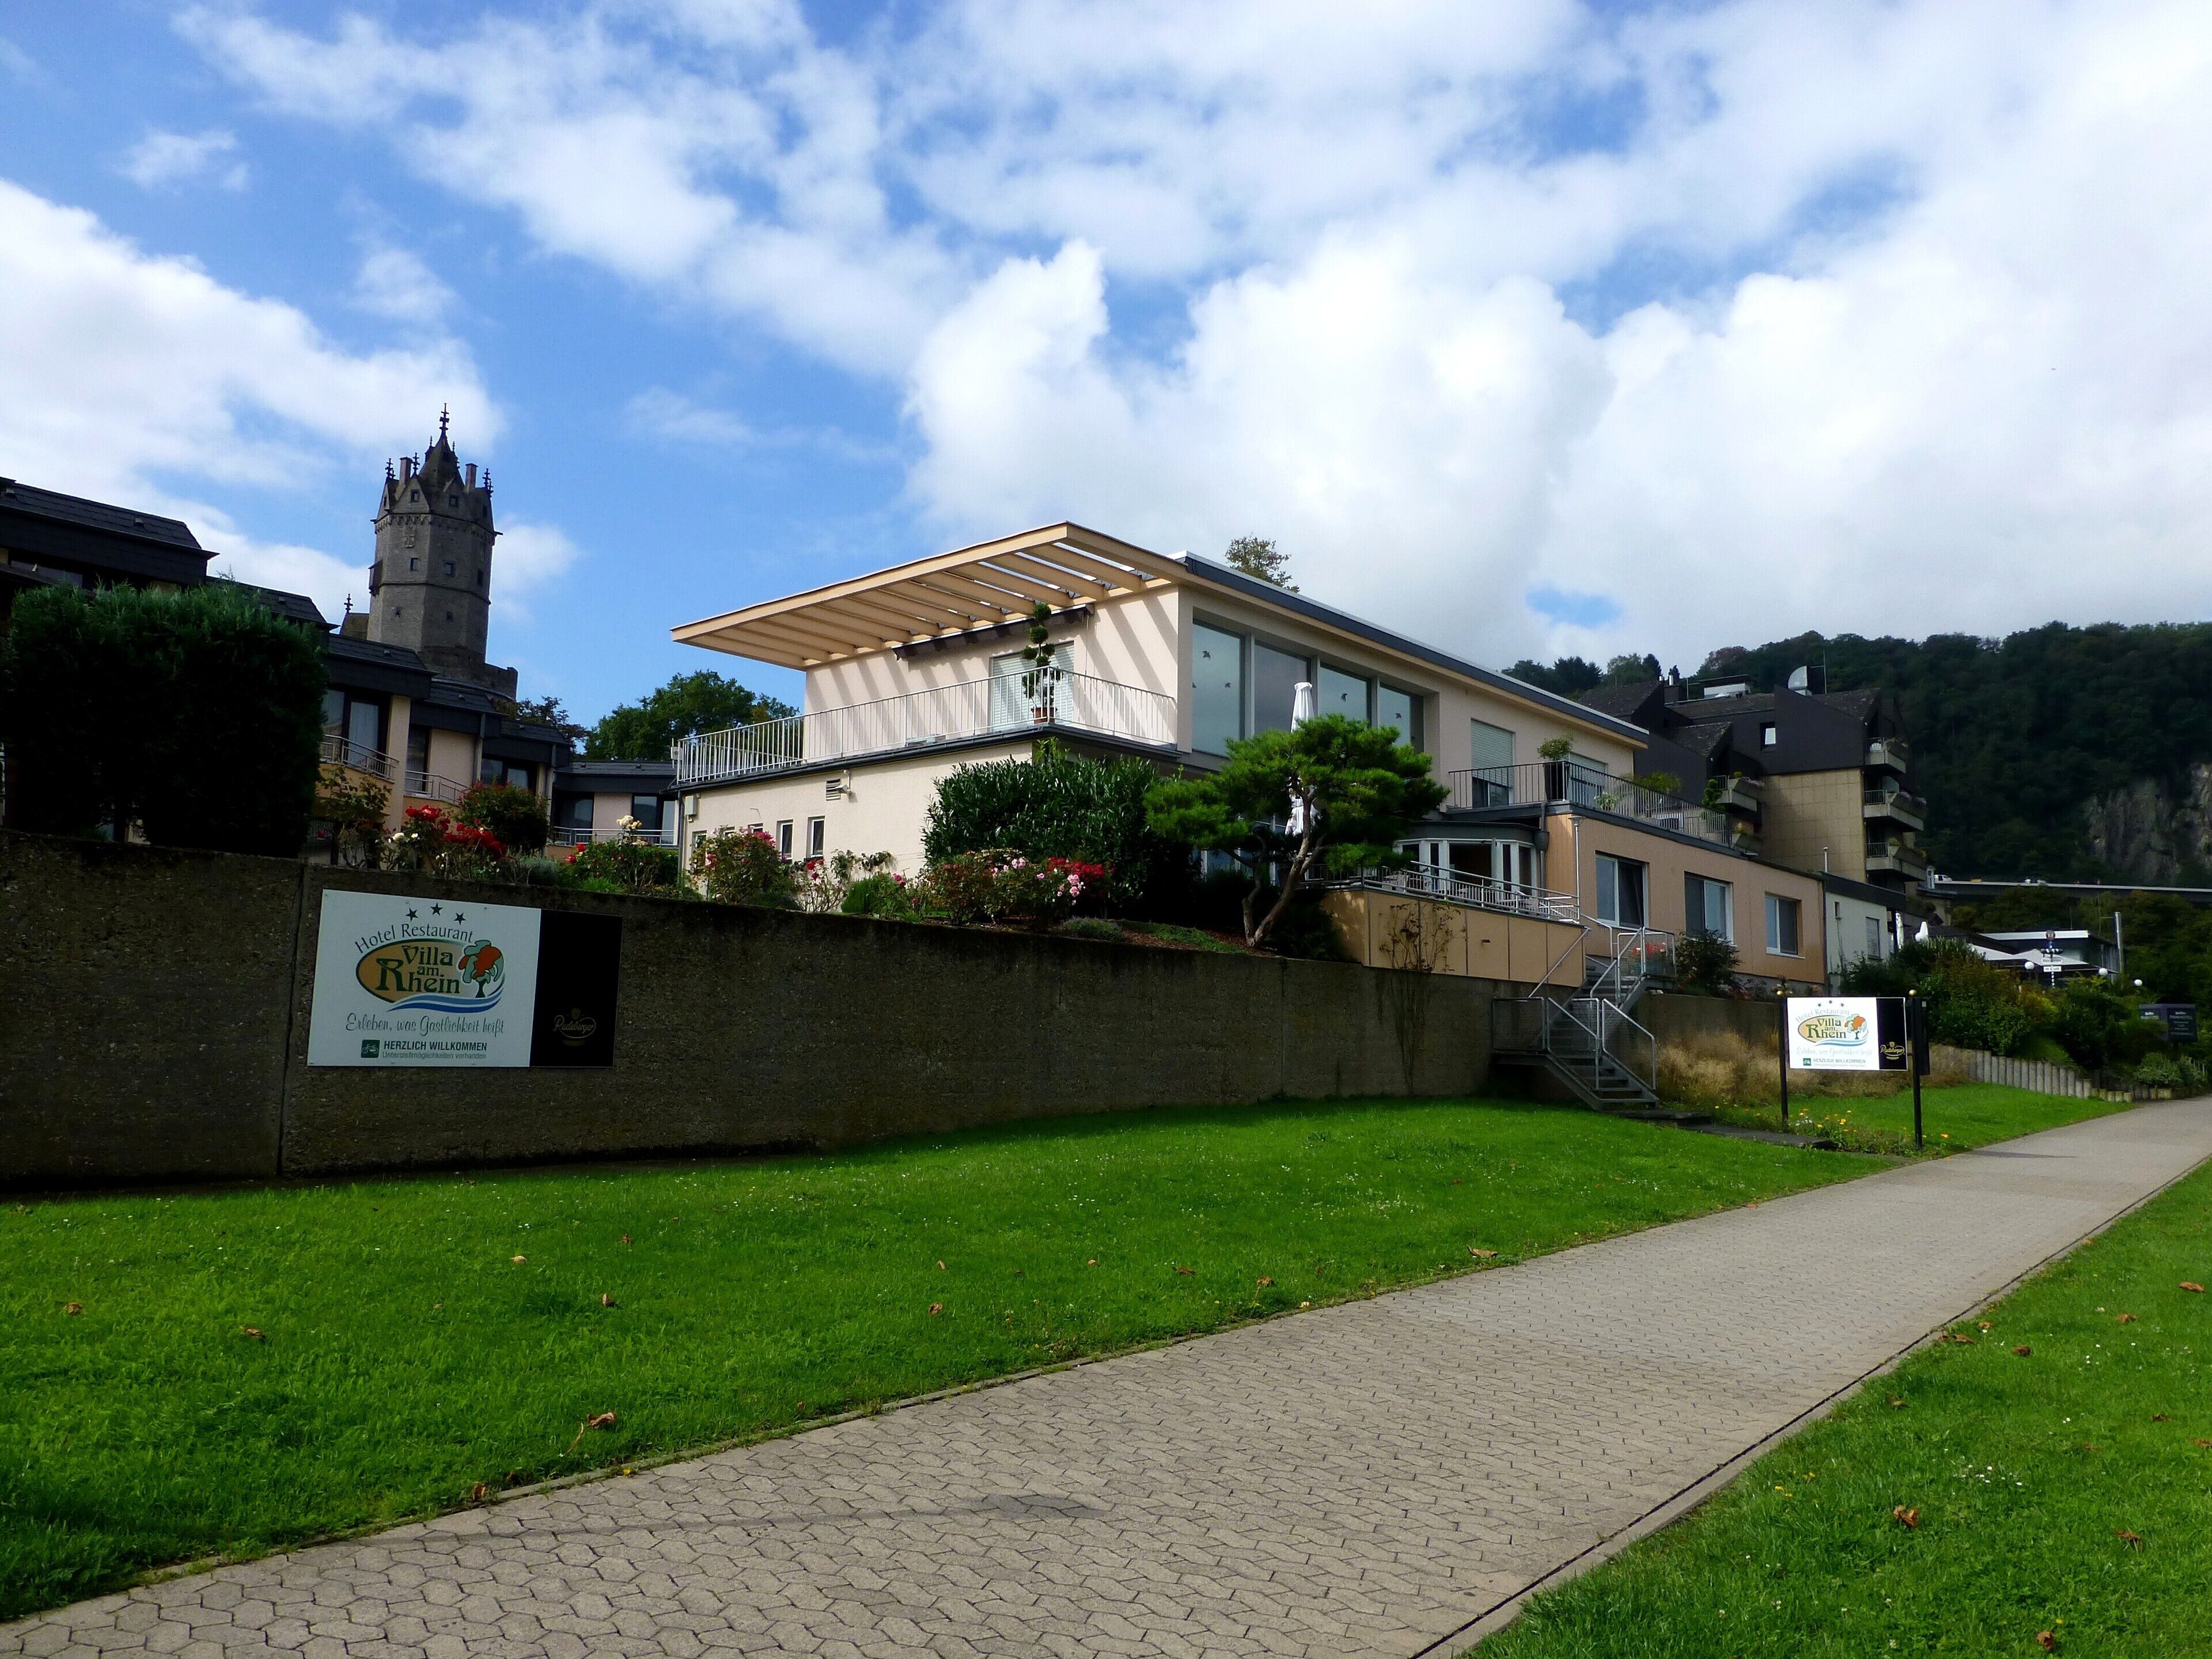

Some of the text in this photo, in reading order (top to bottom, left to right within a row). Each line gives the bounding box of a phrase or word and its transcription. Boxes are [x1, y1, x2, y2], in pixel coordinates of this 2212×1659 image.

[355, 923, 474, 953] Hotel Restaurant
[402, 945, 453, 966] Villa
[375, 958, 460, 994] Rhein
[417, 966, 438, 976] am
[1795, 1010, 1813, 1023] Hotel
[1817, 1018, 1842, 1027] Villa
[346, 1013, 504, 1037] Erleben, was Gastlichkeit heißt
[1806, 1024, 1846, 1038] Rhein
[384, 1040, 487, 1051] HERZLICH WILLKOMMEN
